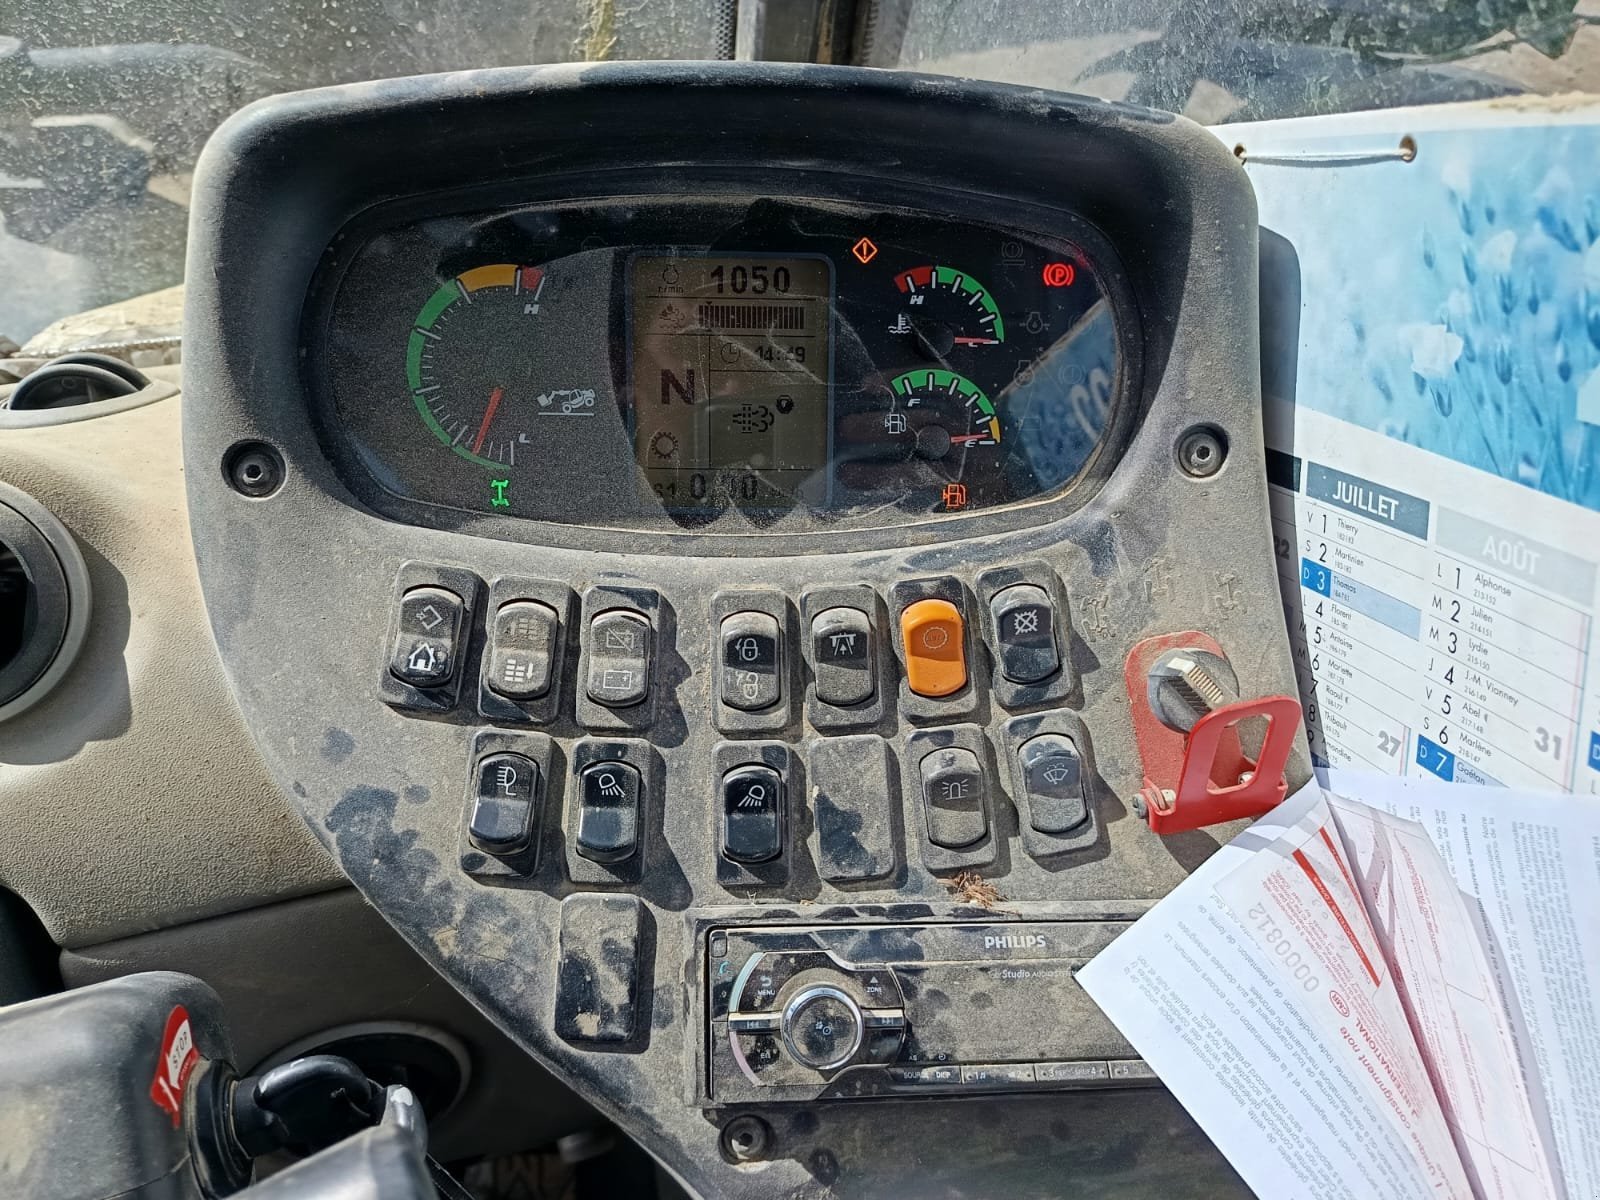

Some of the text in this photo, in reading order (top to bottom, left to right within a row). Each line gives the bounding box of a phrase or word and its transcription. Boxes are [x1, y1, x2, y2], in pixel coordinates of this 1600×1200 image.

[710, 265, 791, 294] 1050
[524, 304, 540, 314] H
[661, 369, 695, 405] N
[908, 398, 921, 407] F
[519, 433, 530, 444] L
[1332, 480, 1399, 521] JUILLET
[1307, 511, 1359, 536] V 1 Thierry
[1306, 540, 1311, 552] S
[1320, 543, 1327, 563] 2
[1482, 535, 1541, 575] AOÛT
[1304, 568, 1357, 594] D 3 Thomas
[1437, 563, 1512, 597] L 1 Alphonse
[1303, 595, 1352, 620] L 4 Florent
[1432, 595, 1493, 624] M 2 Julien
[1313, 626, 1322, 644] 5
[1330, 632, 1353, 650] Antoine
[1429, 626, 1489, 656] M 3 Lydie
[1312, 654, 1320, 671] 6
[1311, 677, 1319, 694] 7
[1429, 658, 1434, 671] J
[1444, 666, 1454, 685] 4
[1486, 681, 1519, 706] Vianney
[1308, 704, 1315, 722] 8
[1426, 687, 1481, 719] V 5 Abel
[1307, 730, 1314, 745] 9
[1377, 730, 1401, 758] 27
[1424, 716, 1492, 756] S 6 Marlène
[1534, 726, 1562, 760] 31
[1420, 746, 1427, 758] D
[1436, 752, 1447, 771] 7
[1457, 762, 1485, 785] Gaétan
[984, 935, 1046, 949] PHILIPS
[1244, 900, 1322, 994] 0000812
[1337, 1025, 1361, 1054] note
[1356, 1051, 1414, 1131] consignment
